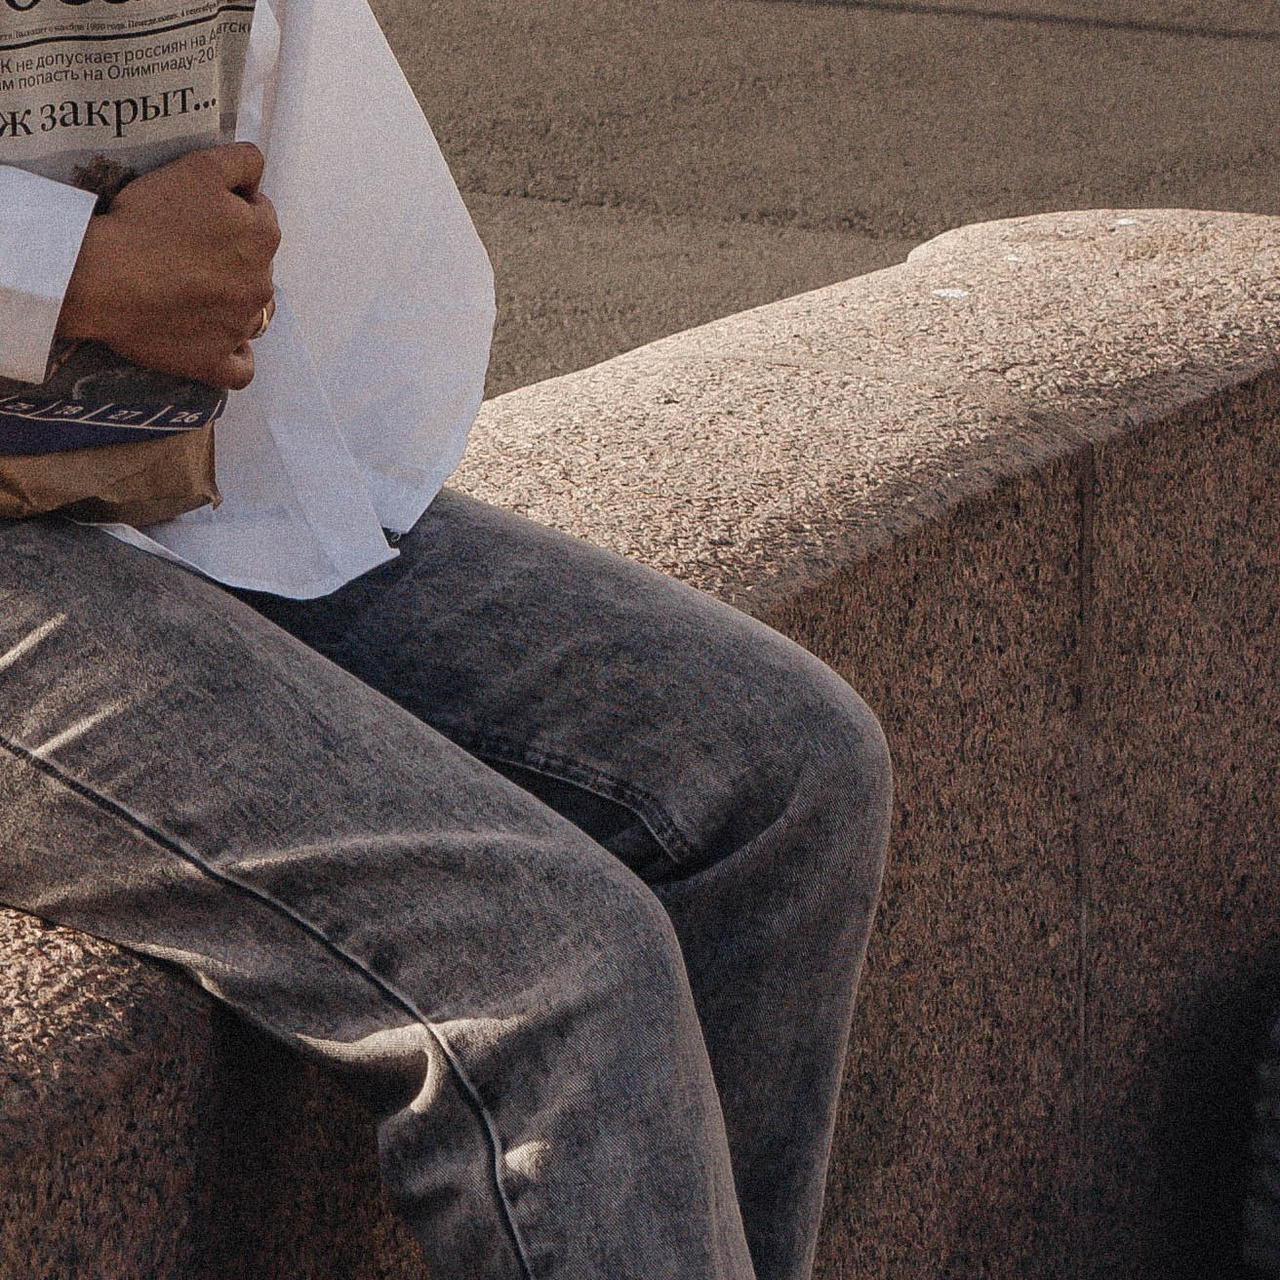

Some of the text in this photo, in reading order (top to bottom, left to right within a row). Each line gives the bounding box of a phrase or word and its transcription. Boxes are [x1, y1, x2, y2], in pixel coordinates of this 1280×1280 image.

[16, 59, 32, 72] не
[35, 49, 120, 73] допускает
[124, 38, 188, 63] россиян
[191, 35, 207, 48] на
[18, 69, 80, 90] попасть
[83, 69, 104, 82] на
[107, 46, 218, 81] Олимпиаду-20
[40, 86, 217, 138] закрыт...
[106, 409, 144, 422] 27
[169, 410, 204, 424] 26
